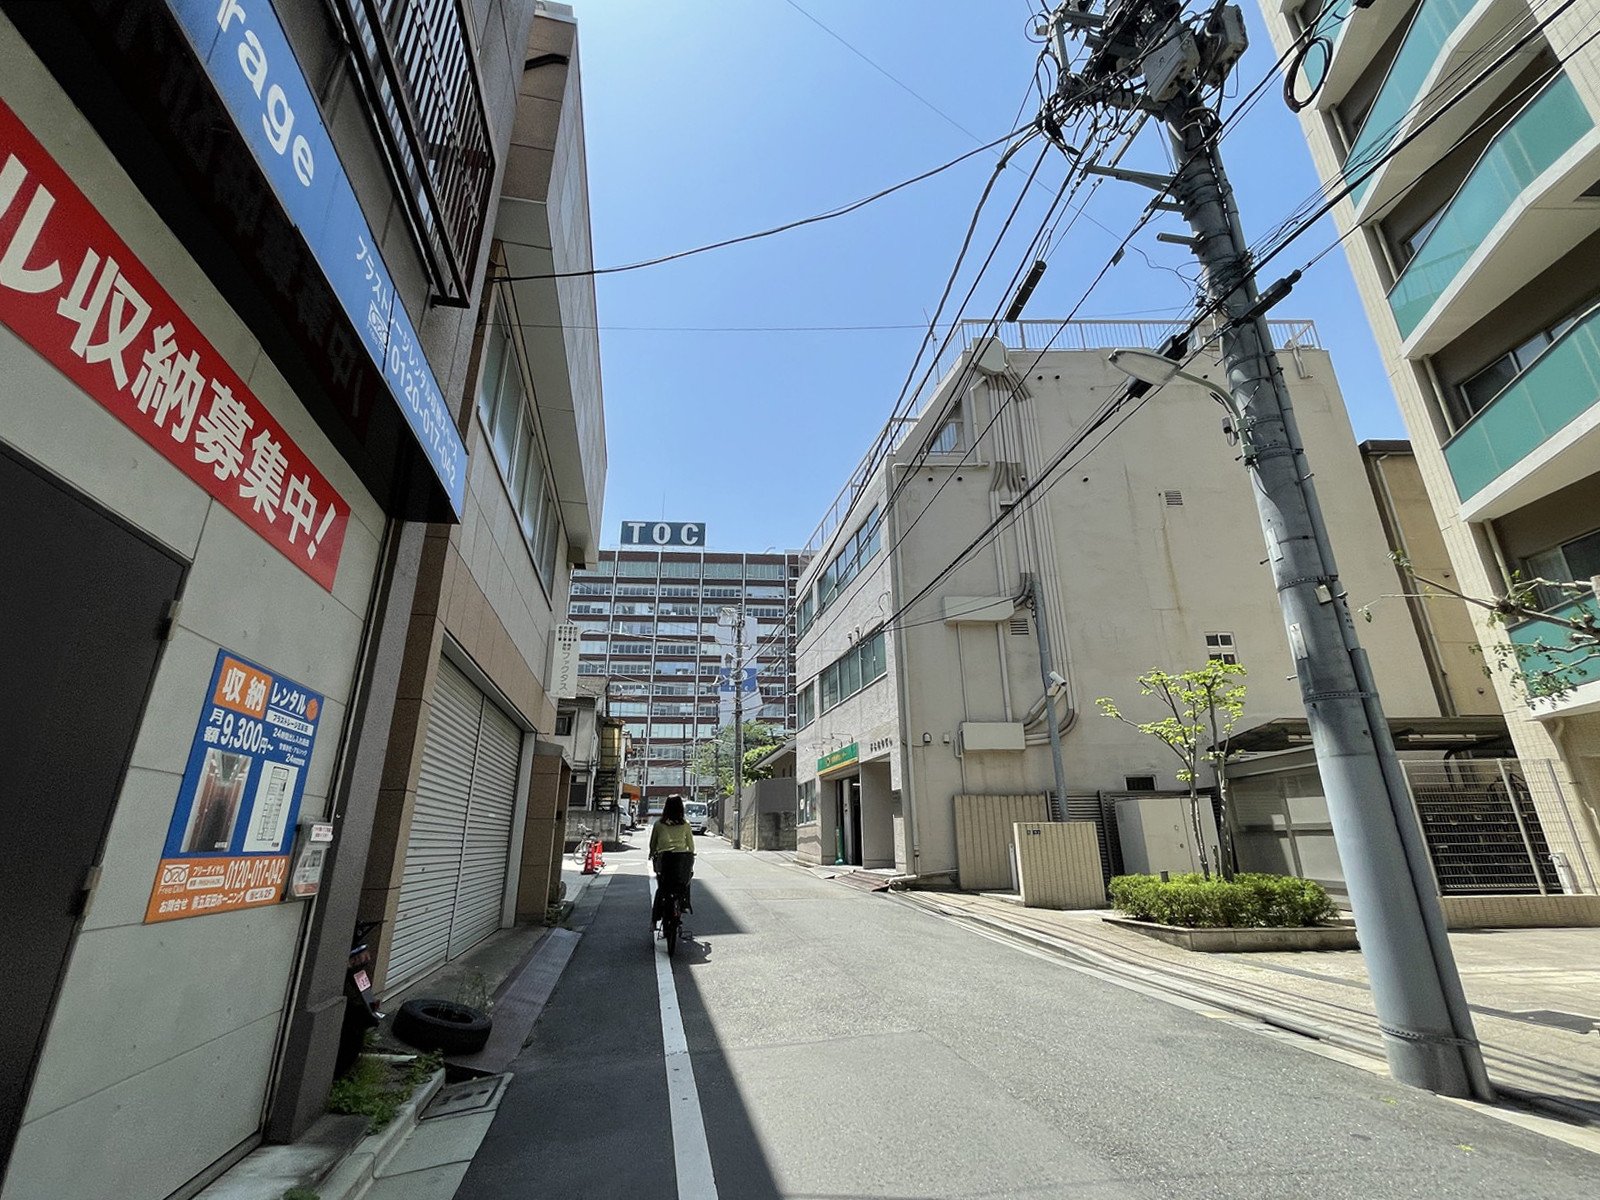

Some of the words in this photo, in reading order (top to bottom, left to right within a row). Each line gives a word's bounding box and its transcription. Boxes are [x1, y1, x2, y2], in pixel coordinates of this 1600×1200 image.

[217, 0, 314, 187] rage
[391, 345, 455, 488] 0120-017-042
[628, 522, 699, 545] TOC
[222, 667, 267, 711] 収納
[271, 682, 306, 715] レンタル
